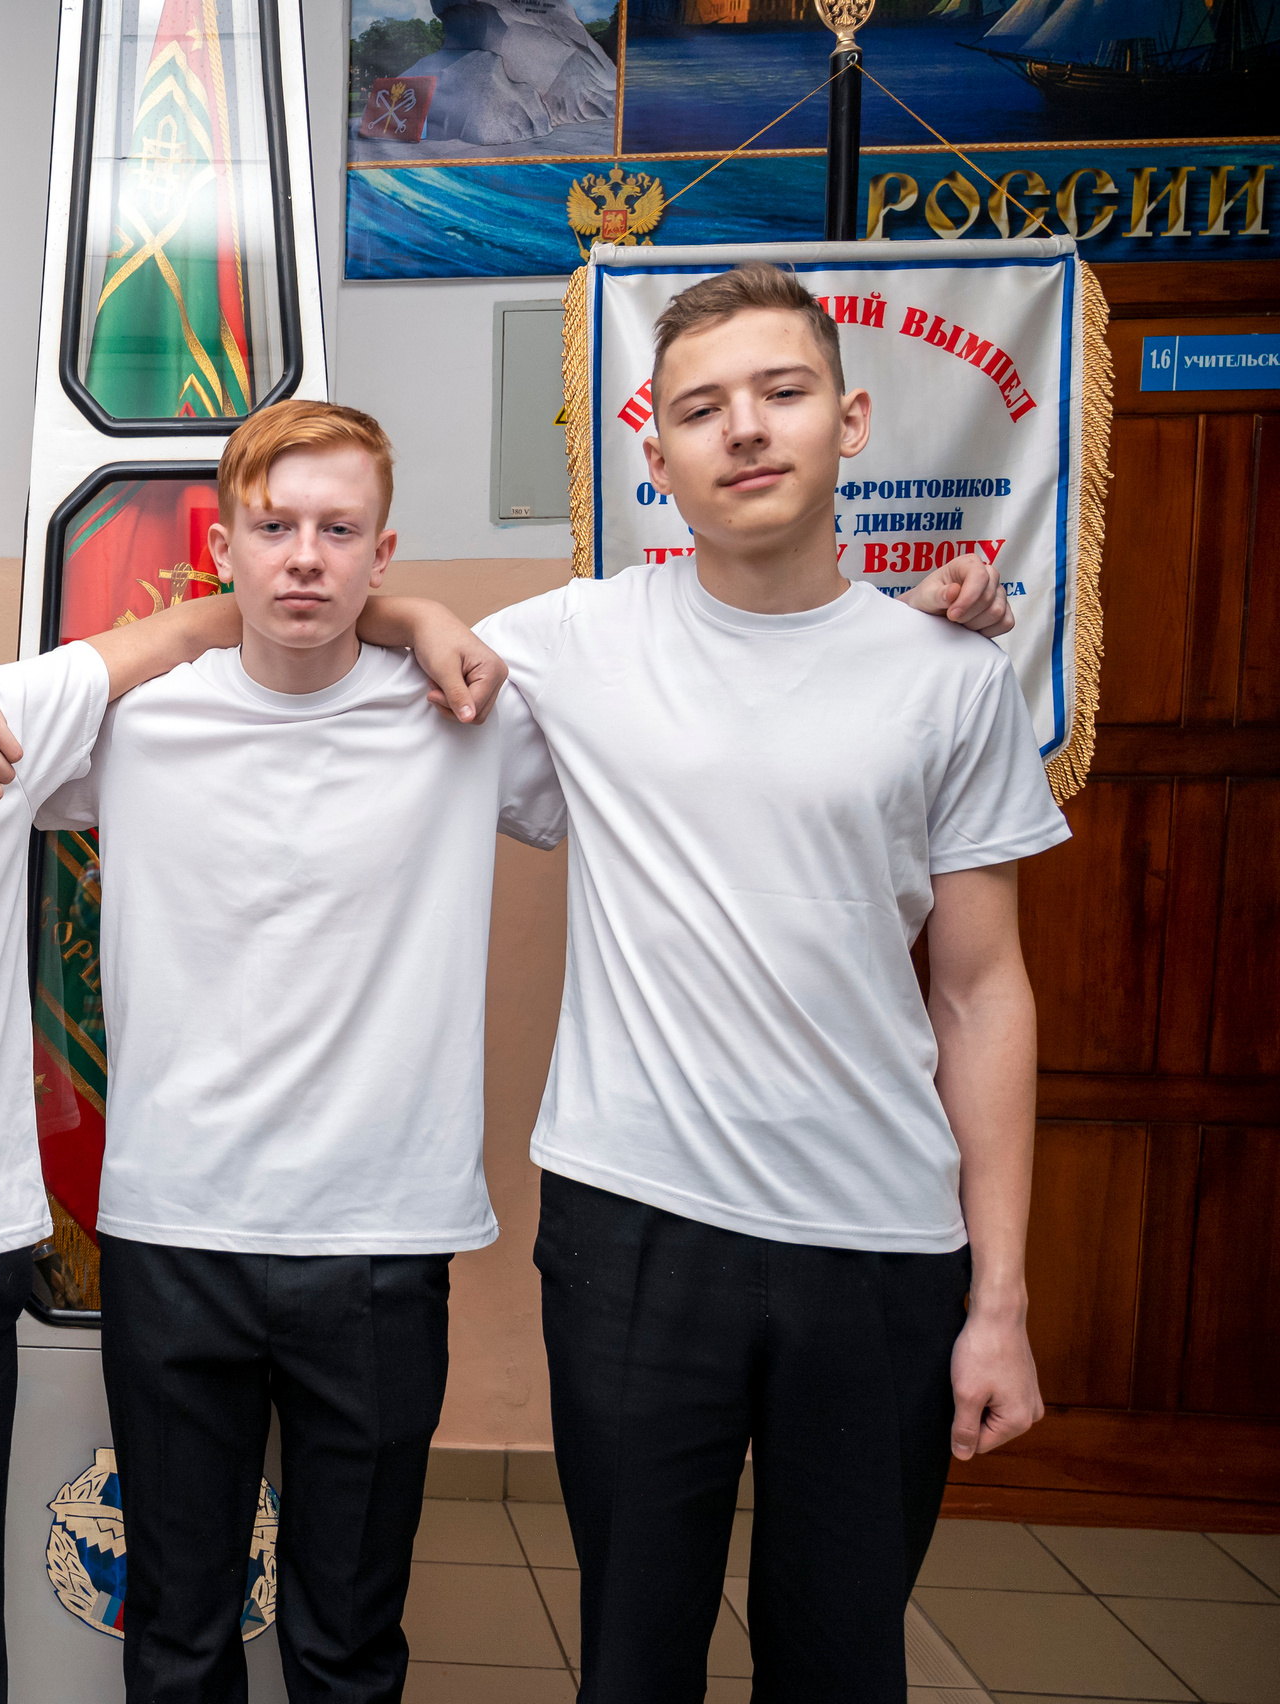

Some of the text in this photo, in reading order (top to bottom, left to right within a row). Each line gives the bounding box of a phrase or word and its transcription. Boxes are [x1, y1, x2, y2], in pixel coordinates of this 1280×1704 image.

[858, 164, 1274, 241] РОССИИ
[899, 306, 1037, 424] ВЫМПЕЛ
[1150, 348, 1171, 369] 1.6
[854, 507, 964, 536] ДИВИЗИЙ
